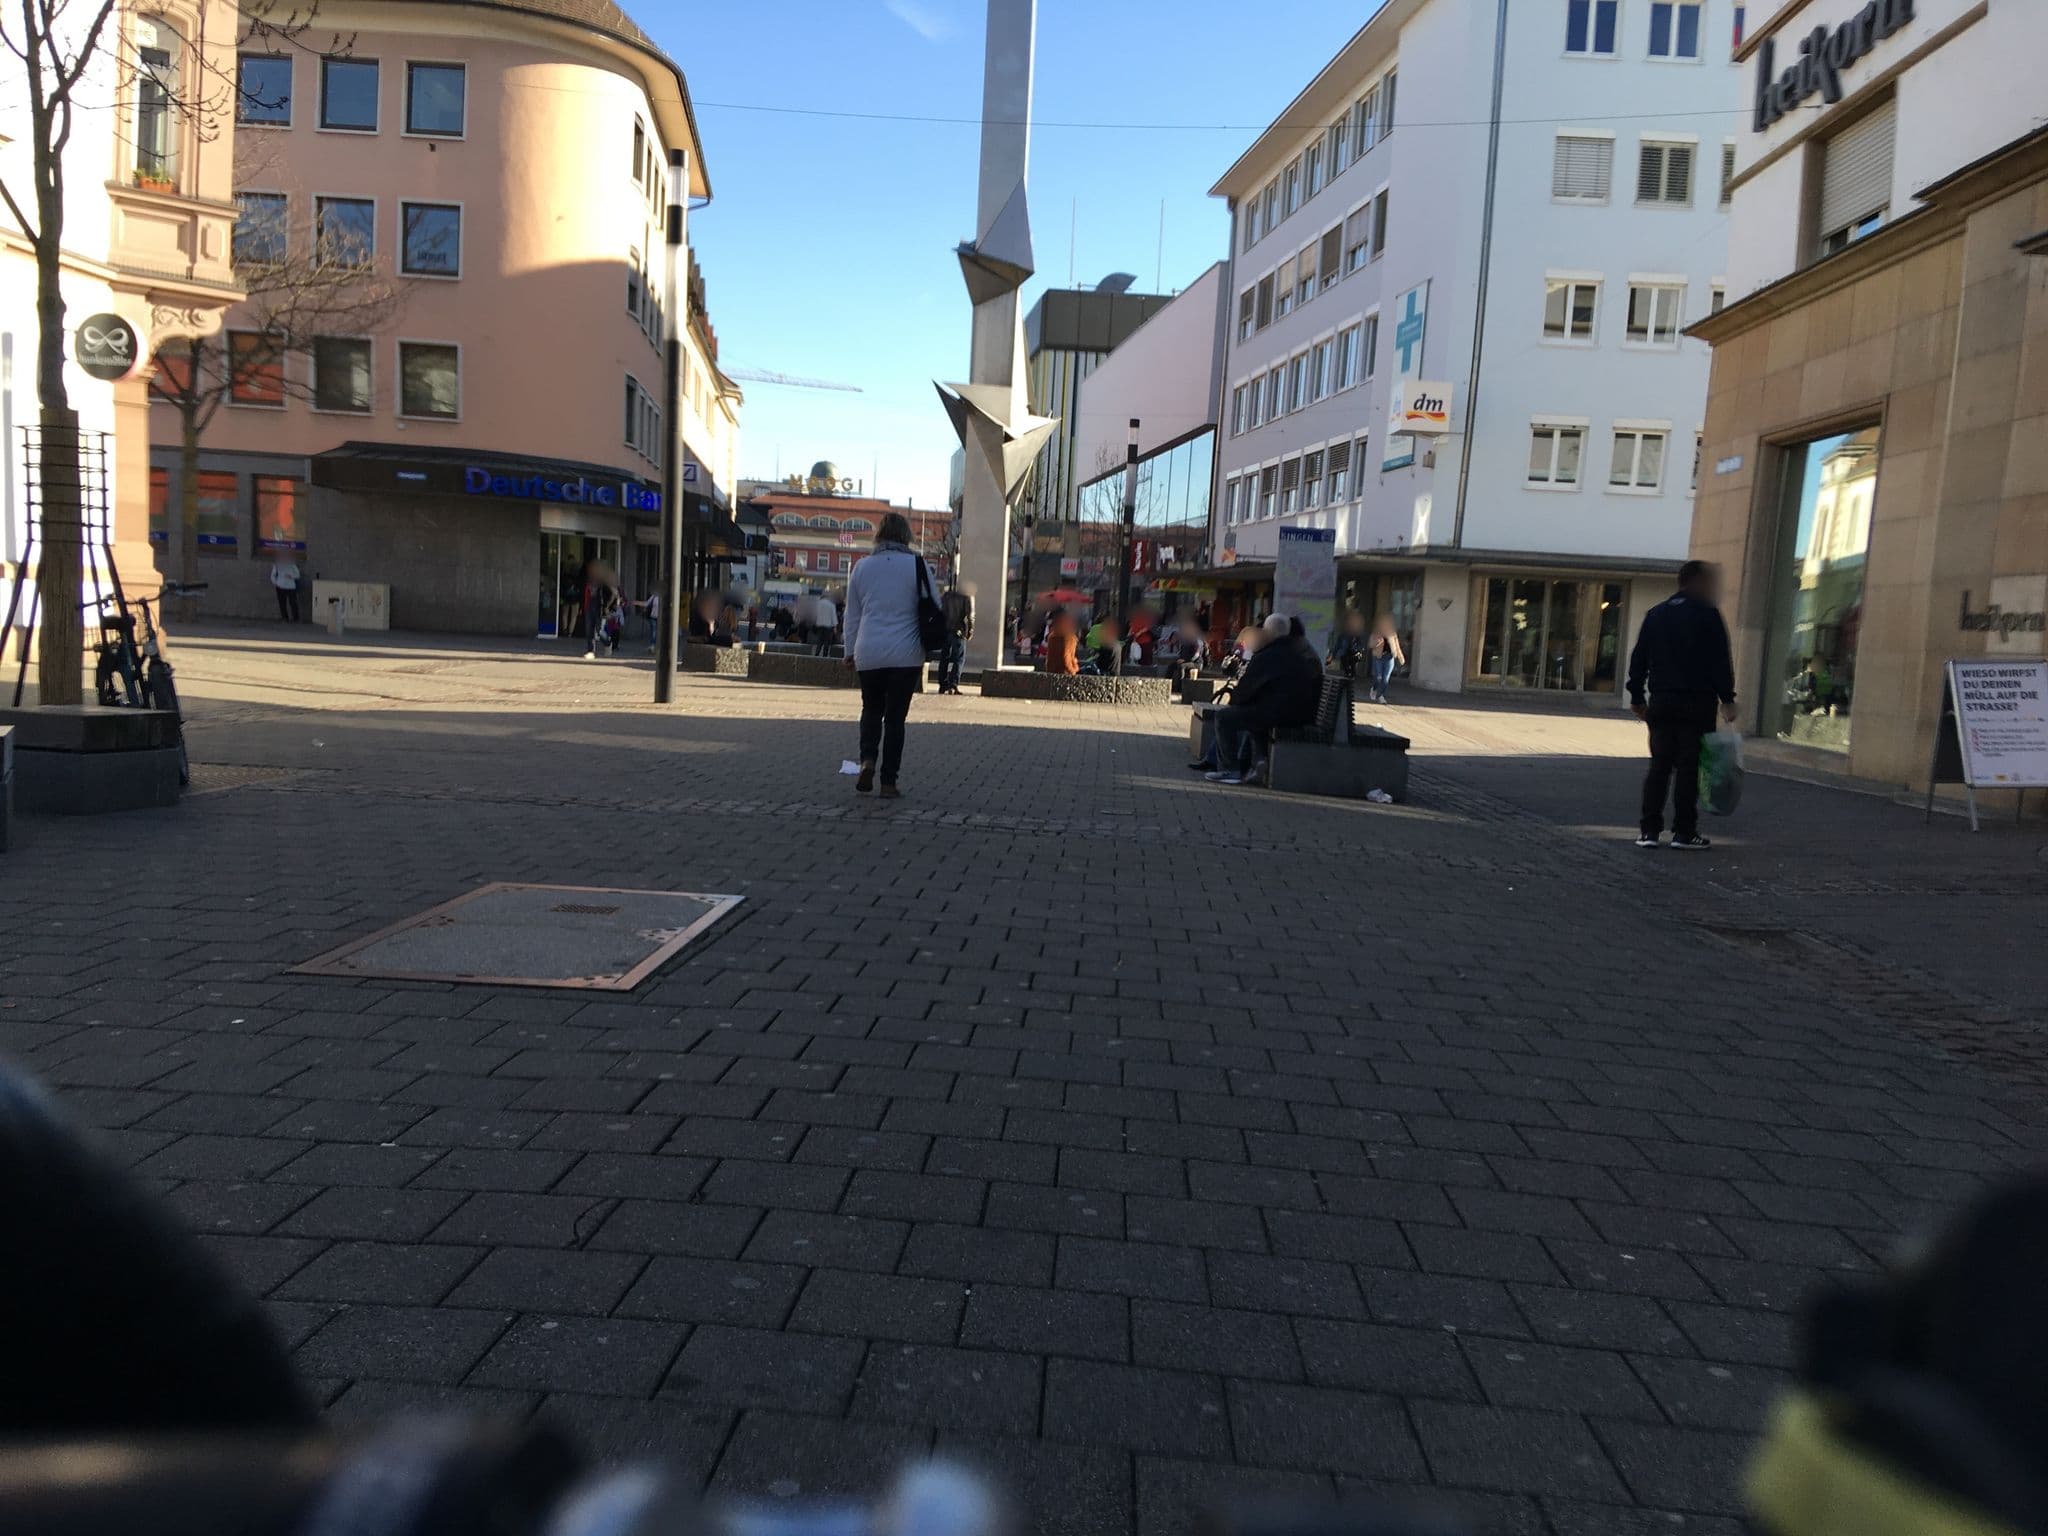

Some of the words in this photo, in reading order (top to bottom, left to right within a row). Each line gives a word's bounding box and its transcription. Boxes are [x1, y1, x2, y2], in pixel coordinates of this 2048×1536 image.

[1413, 394, 1443, 412] dm
[465, 467, 616, 505] Deutsche
[621, 482, 663, 512] Ba
[1962, 669, 1996, 678] WIESO
[1998, 668, 2037, 678] WIRFST
[1963, 681, 1979, 689] DU
[1981, 680, 2021, 689] DEINEN
[1964, 690, 1995, 700] MÜLL
[1997, 691, 2017, 700] AUF
[2020, 690, 2038, 700] DIE
[1966, 702, 2018, 712] STRASSE?
